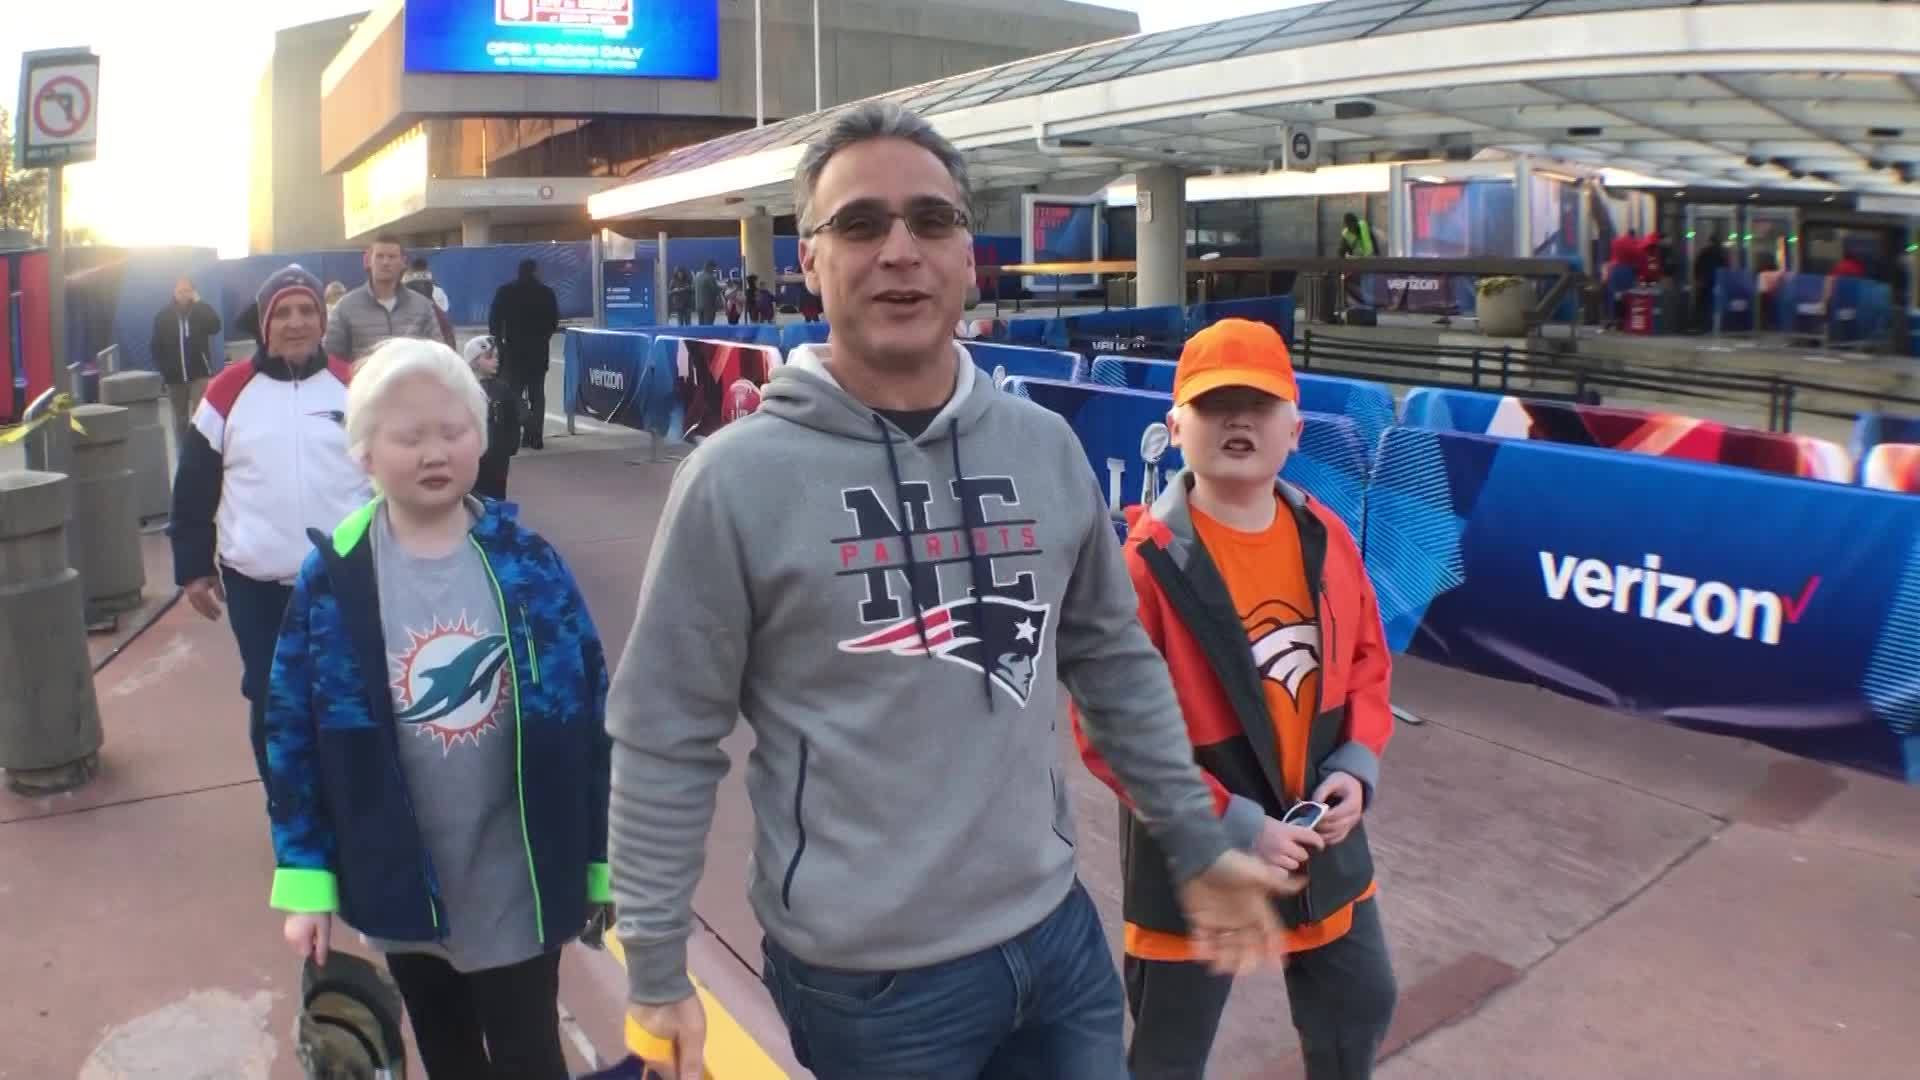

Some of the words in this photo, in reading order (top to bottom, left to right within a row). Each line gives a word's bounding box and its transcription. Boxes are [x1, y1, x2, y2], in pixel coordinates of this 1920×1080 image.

[1387, 275, 1440, 290] verizon
[589, 363, 624, 390] verizon
[839, 527, 1036, 568] PARIOTS
[1538, 551, 1783, 646] verizon
